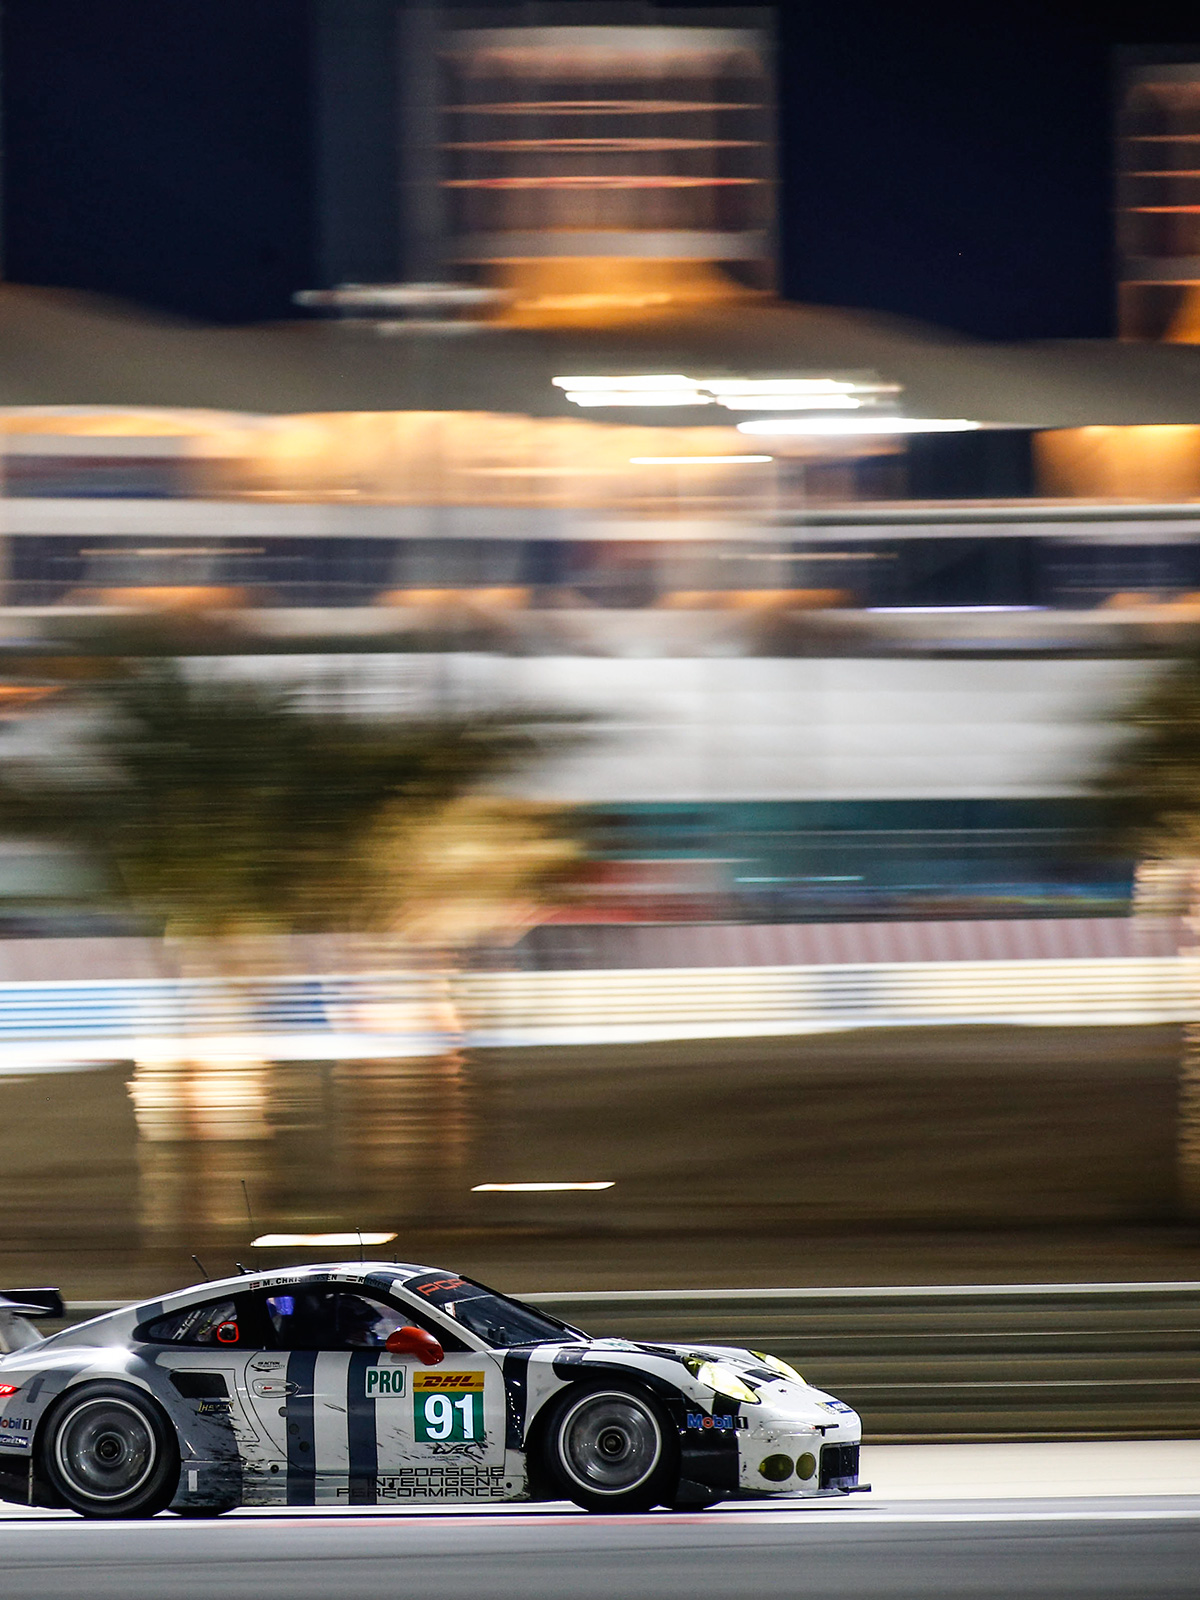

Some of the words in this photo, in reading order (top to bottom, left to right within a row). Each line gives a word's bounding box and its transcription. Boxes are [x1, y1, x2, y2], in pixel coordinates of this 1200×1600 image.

[367, 1370, 404, 1393] PRO
[423, 1375, 475, 1387] DHL
[424, 1393, 474, 1440] 91
[687, 1413, 734, 1429] Mobil
[399, 1466, 505, 1476] PORSCHE
[367, 1477, 503, 1487] INTELLIGENT
[336, 1487, 505, 1497] PERFORMANCE
